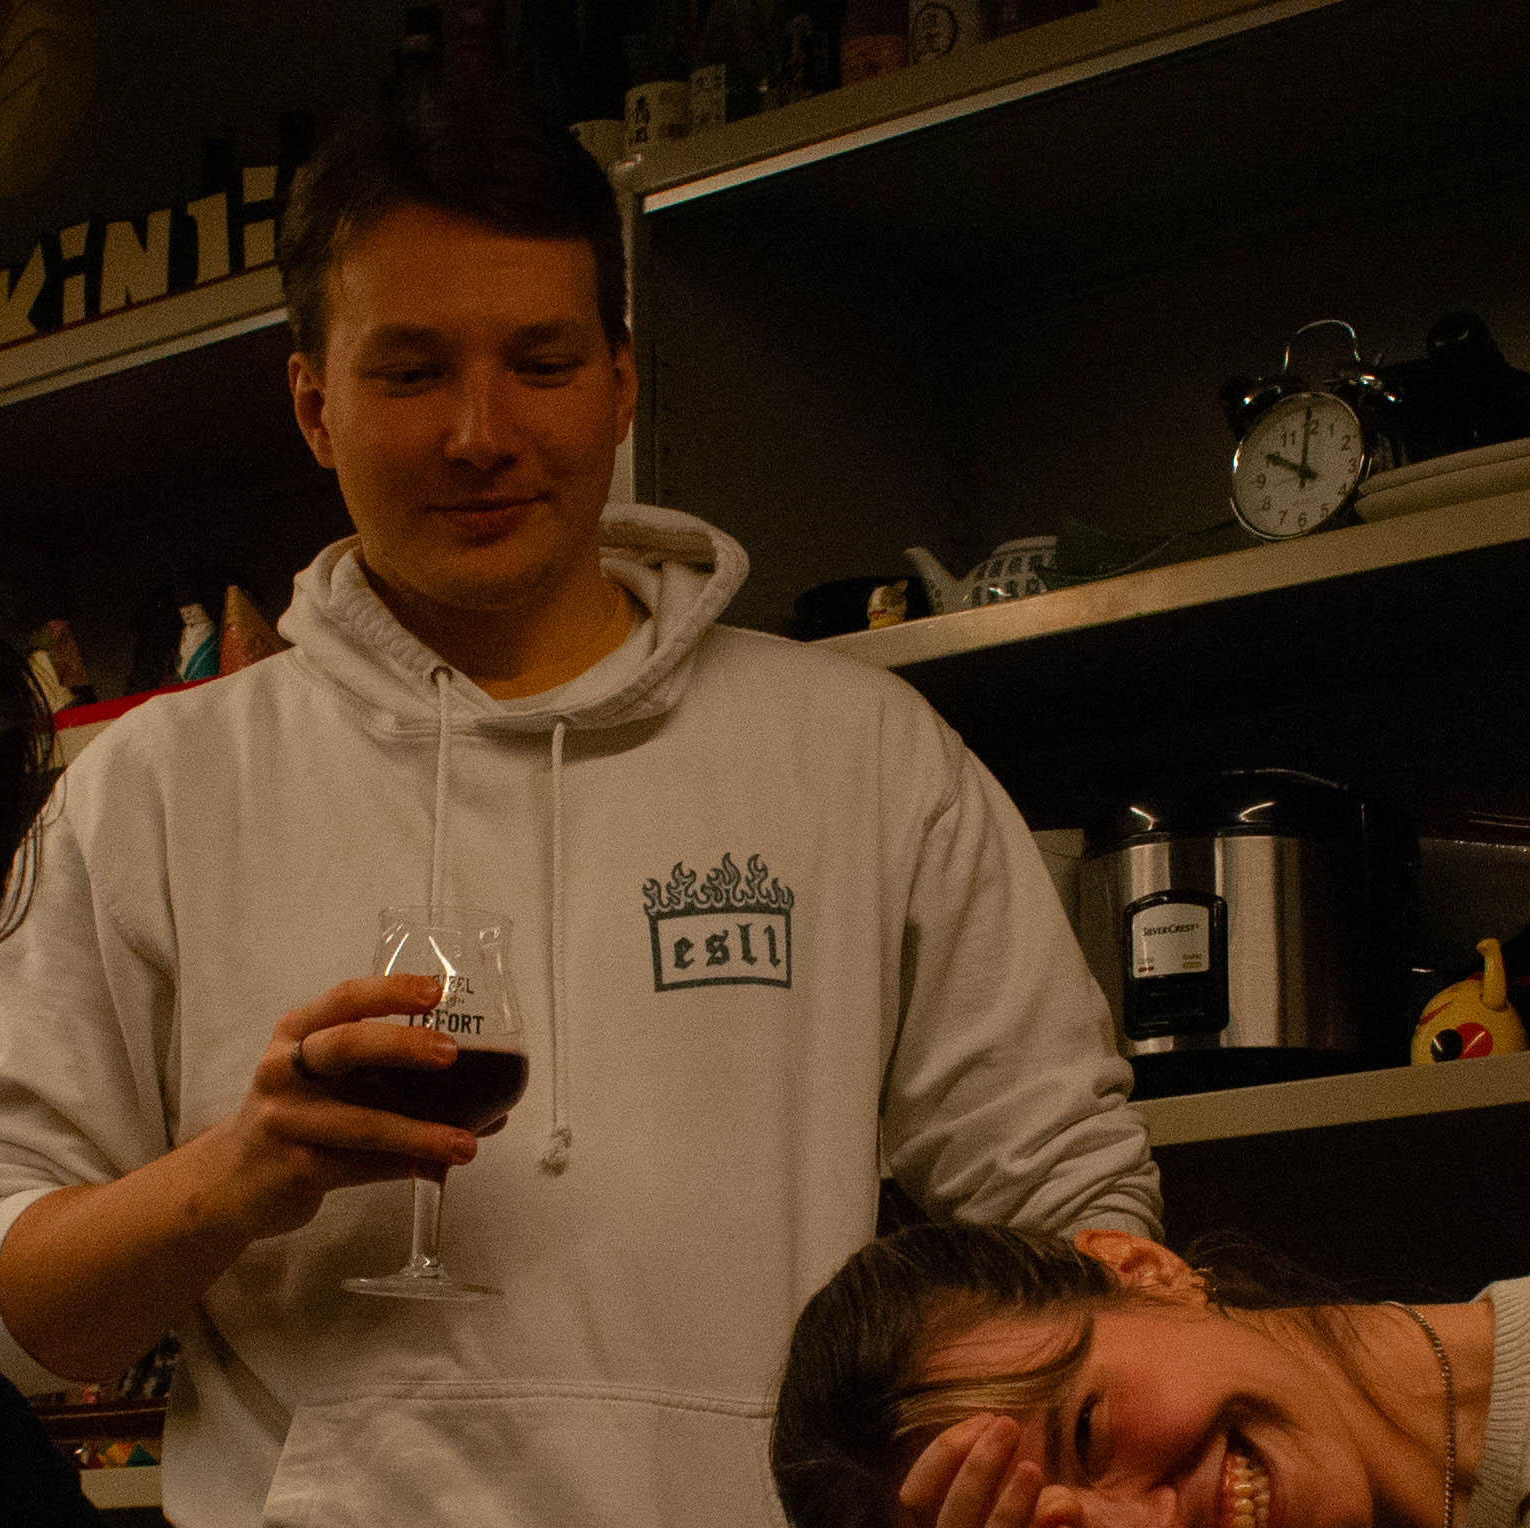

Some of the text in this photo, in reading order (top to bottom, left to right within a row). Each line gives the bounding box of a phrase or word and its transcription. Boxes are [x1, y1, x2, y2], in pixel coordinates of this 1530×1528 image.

[1279, 430, 1297, 448] 11
[1341, 434, 1351, 451] 2
[1347, 458, 1358, 474] 3
[1256, 472, 1267, 490] 9
[1261, 496, 1271, 512] 8
[1320, 502, 1330, 519] 5
[1278, 510, 1288, 527] 7
[1297, 511, 1308, 528] 6
